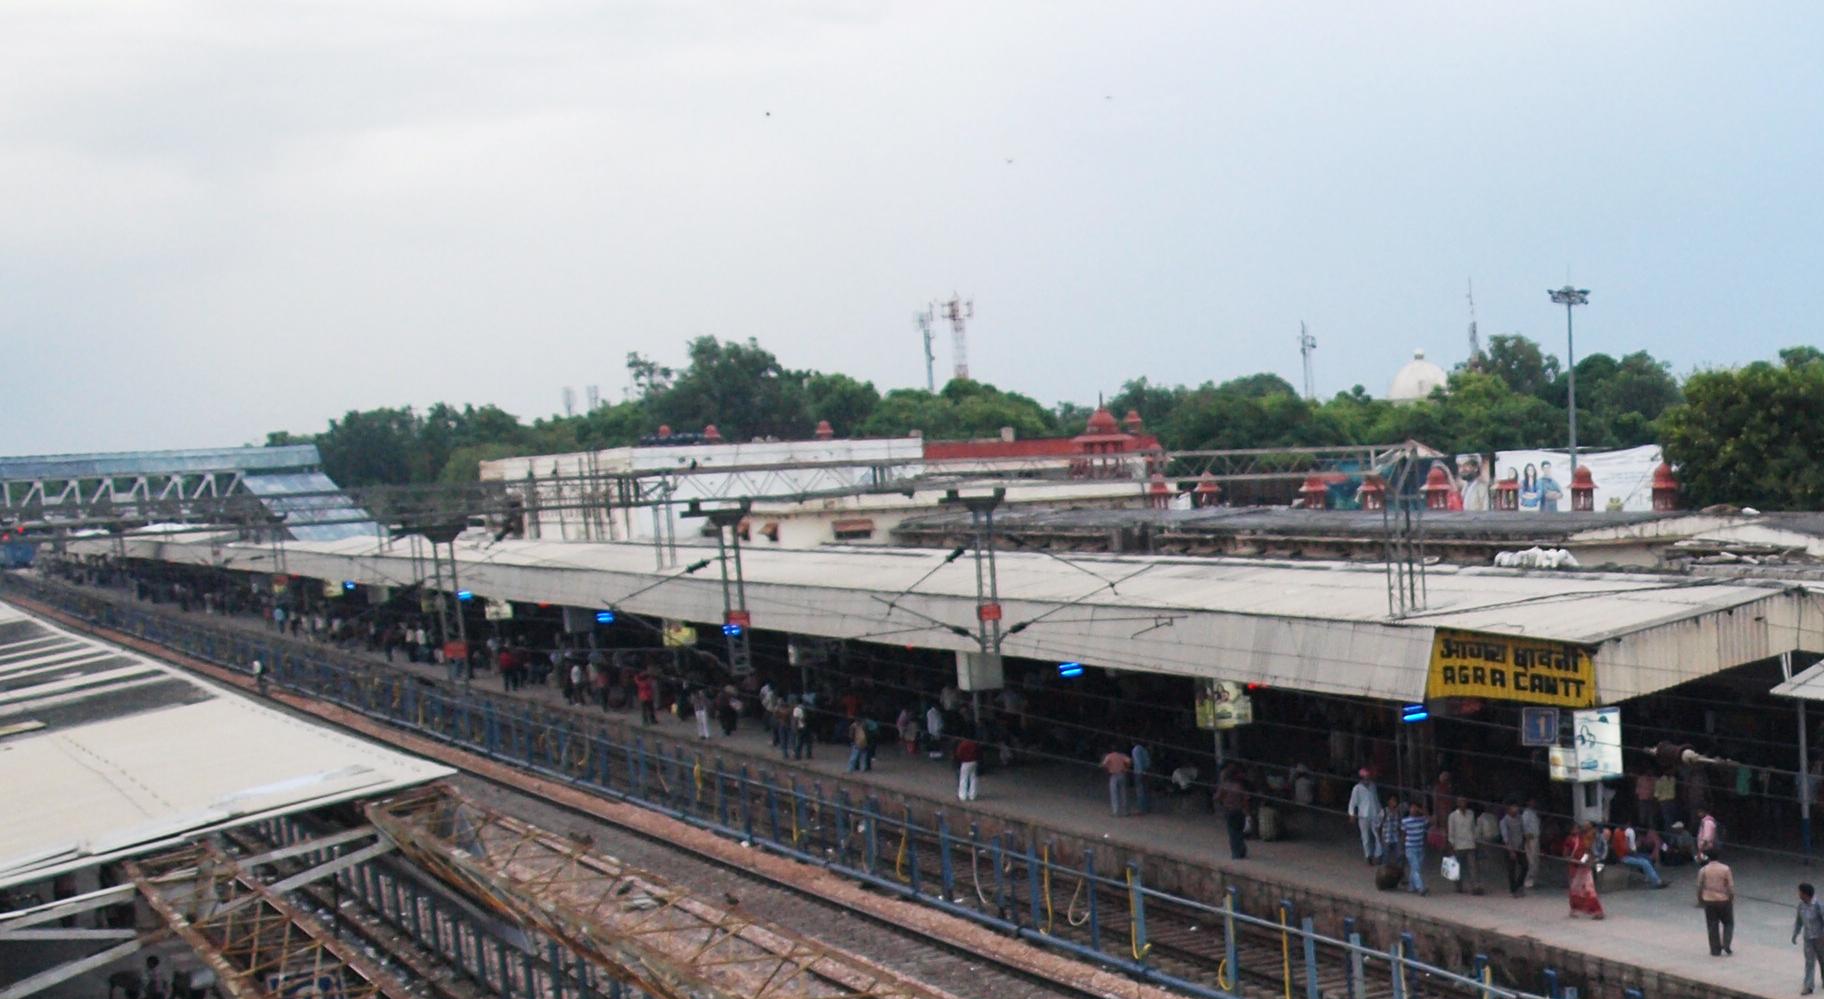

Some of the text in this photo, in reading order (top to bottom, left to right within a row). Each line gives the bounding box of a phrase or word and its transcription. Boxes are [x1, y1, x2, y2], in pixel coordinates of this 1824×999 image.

[1443, 665, 1586, 698] AGRA CANTT
[1536, 714, 1547, 738] 1
